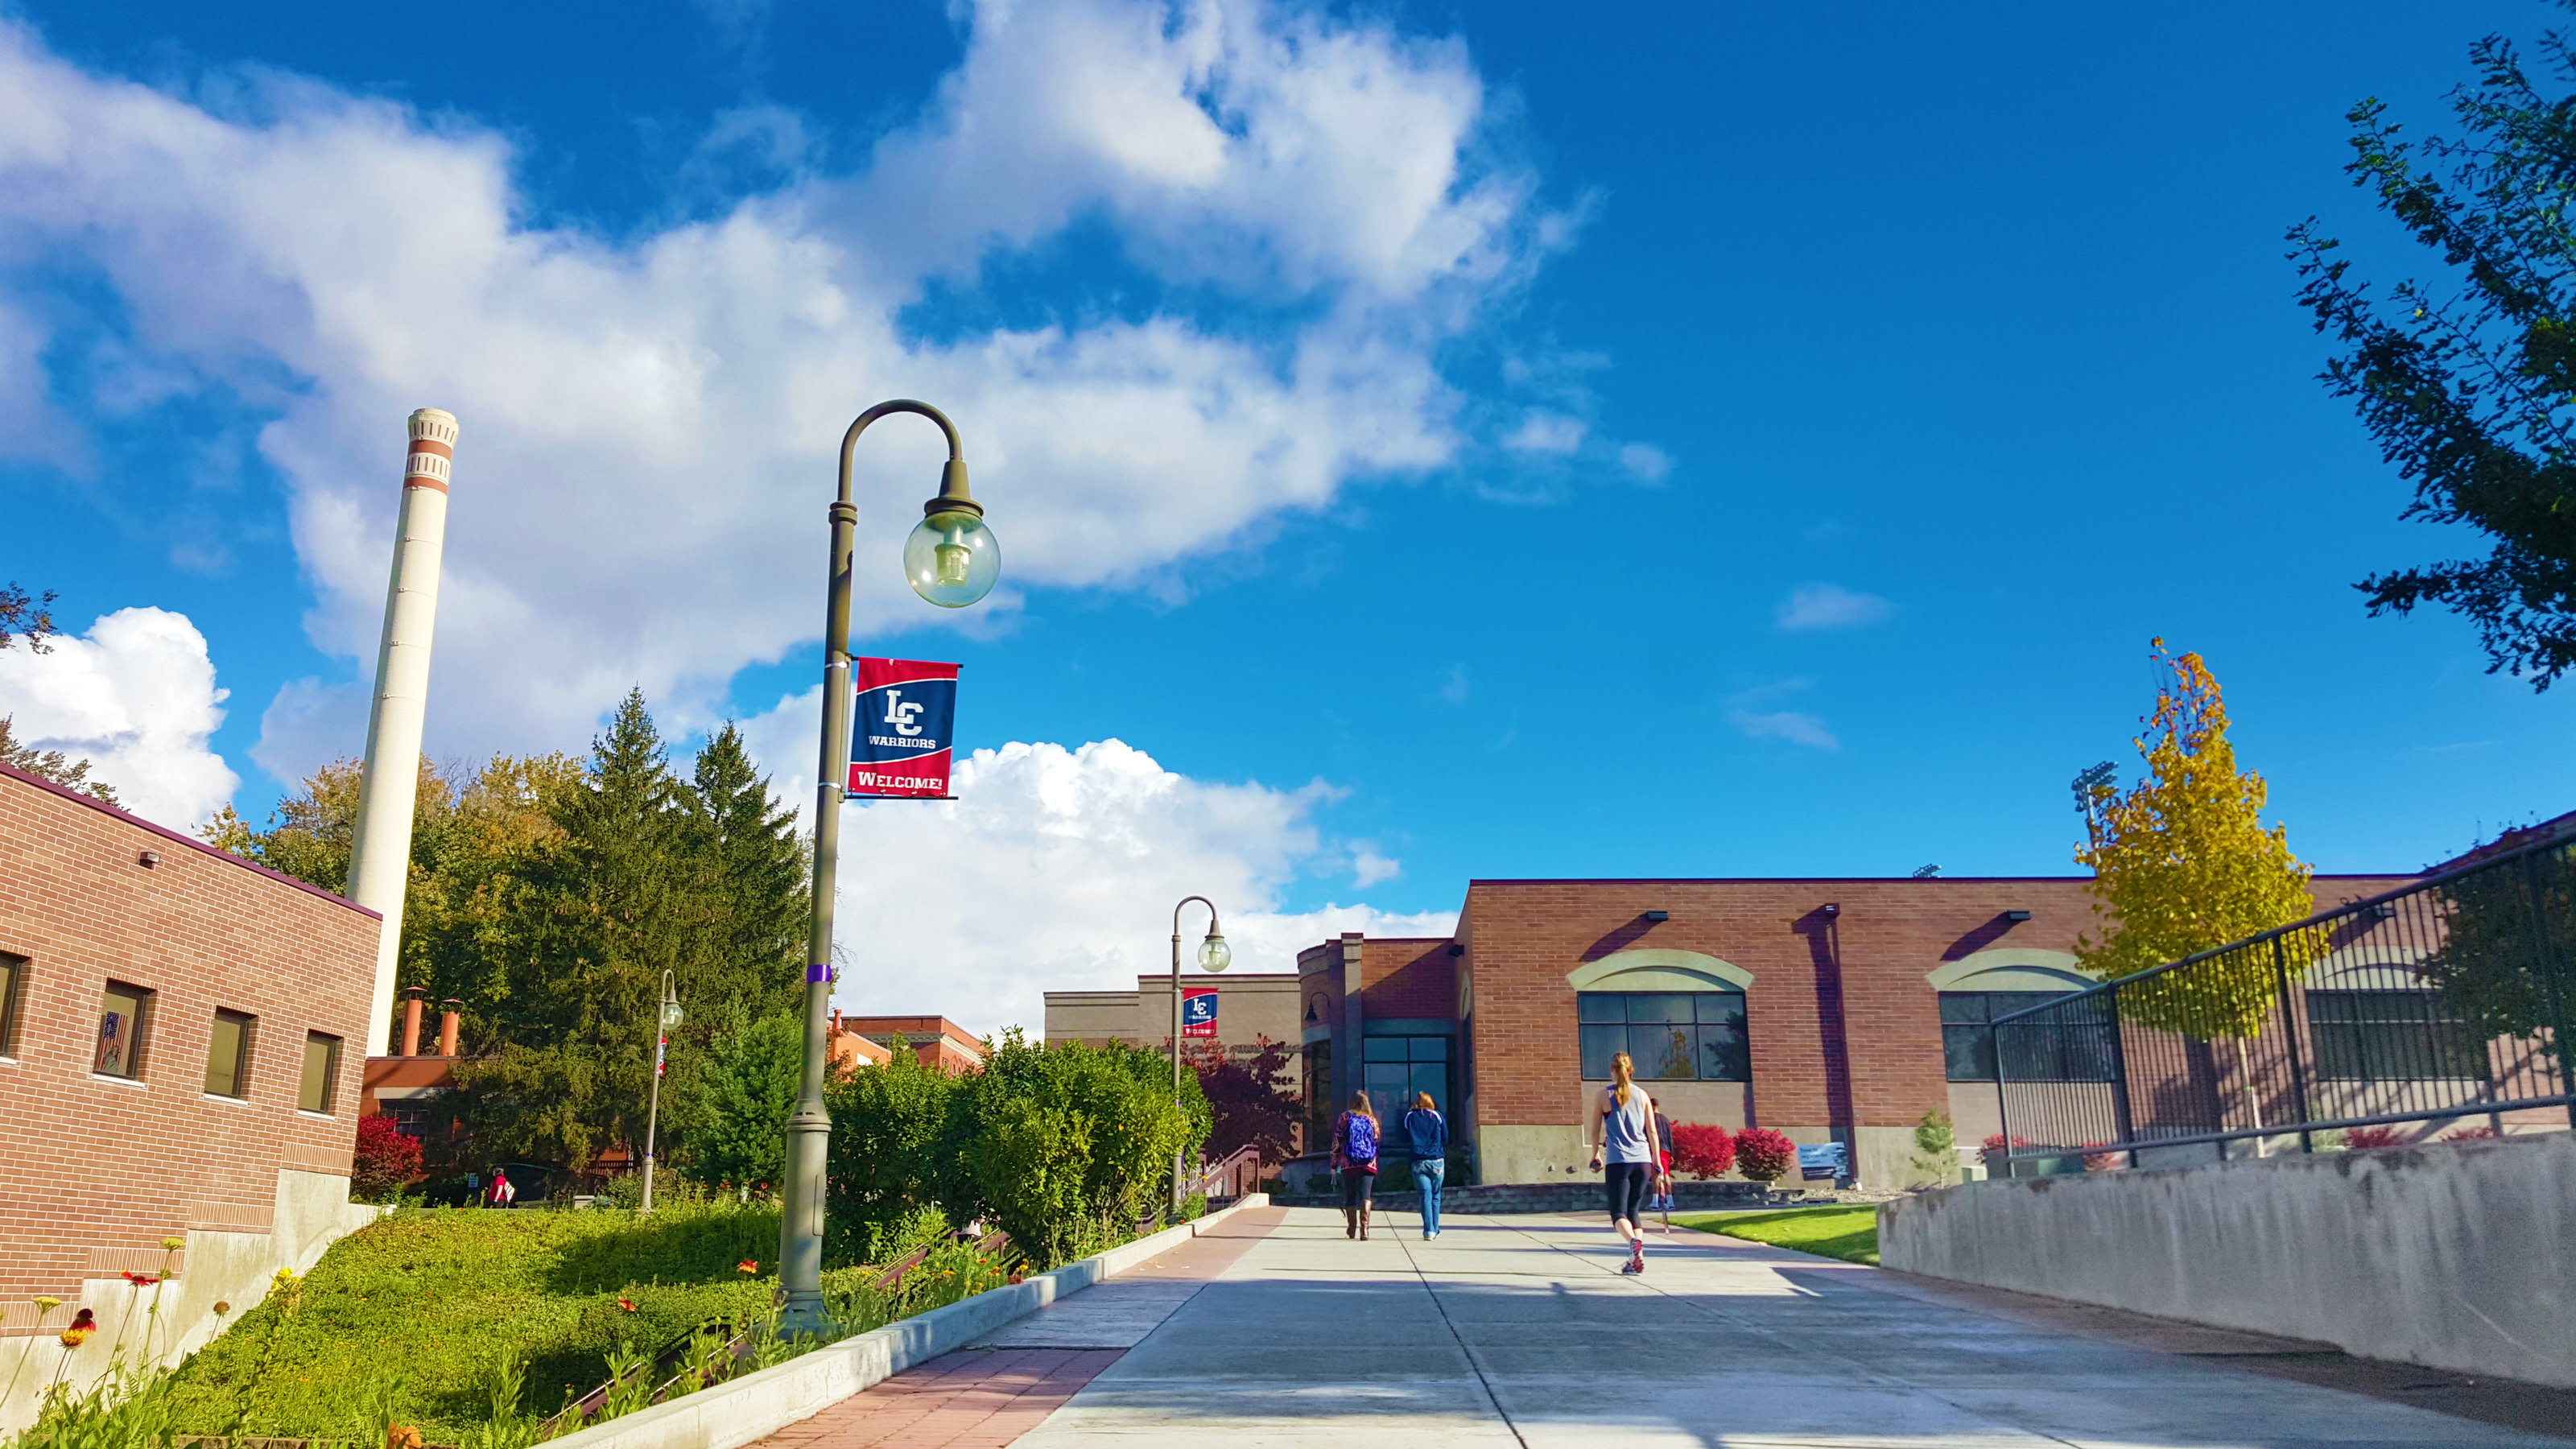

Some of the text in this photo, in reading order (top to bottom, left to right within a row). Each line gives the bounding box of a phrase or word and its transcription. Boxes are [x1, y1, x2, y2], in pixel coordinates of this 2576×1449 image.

[884, 689, 924, 736] LC
[869, 736, 936, 749] WARRIORS
[857, 771, 943, 790] WELCOME!
